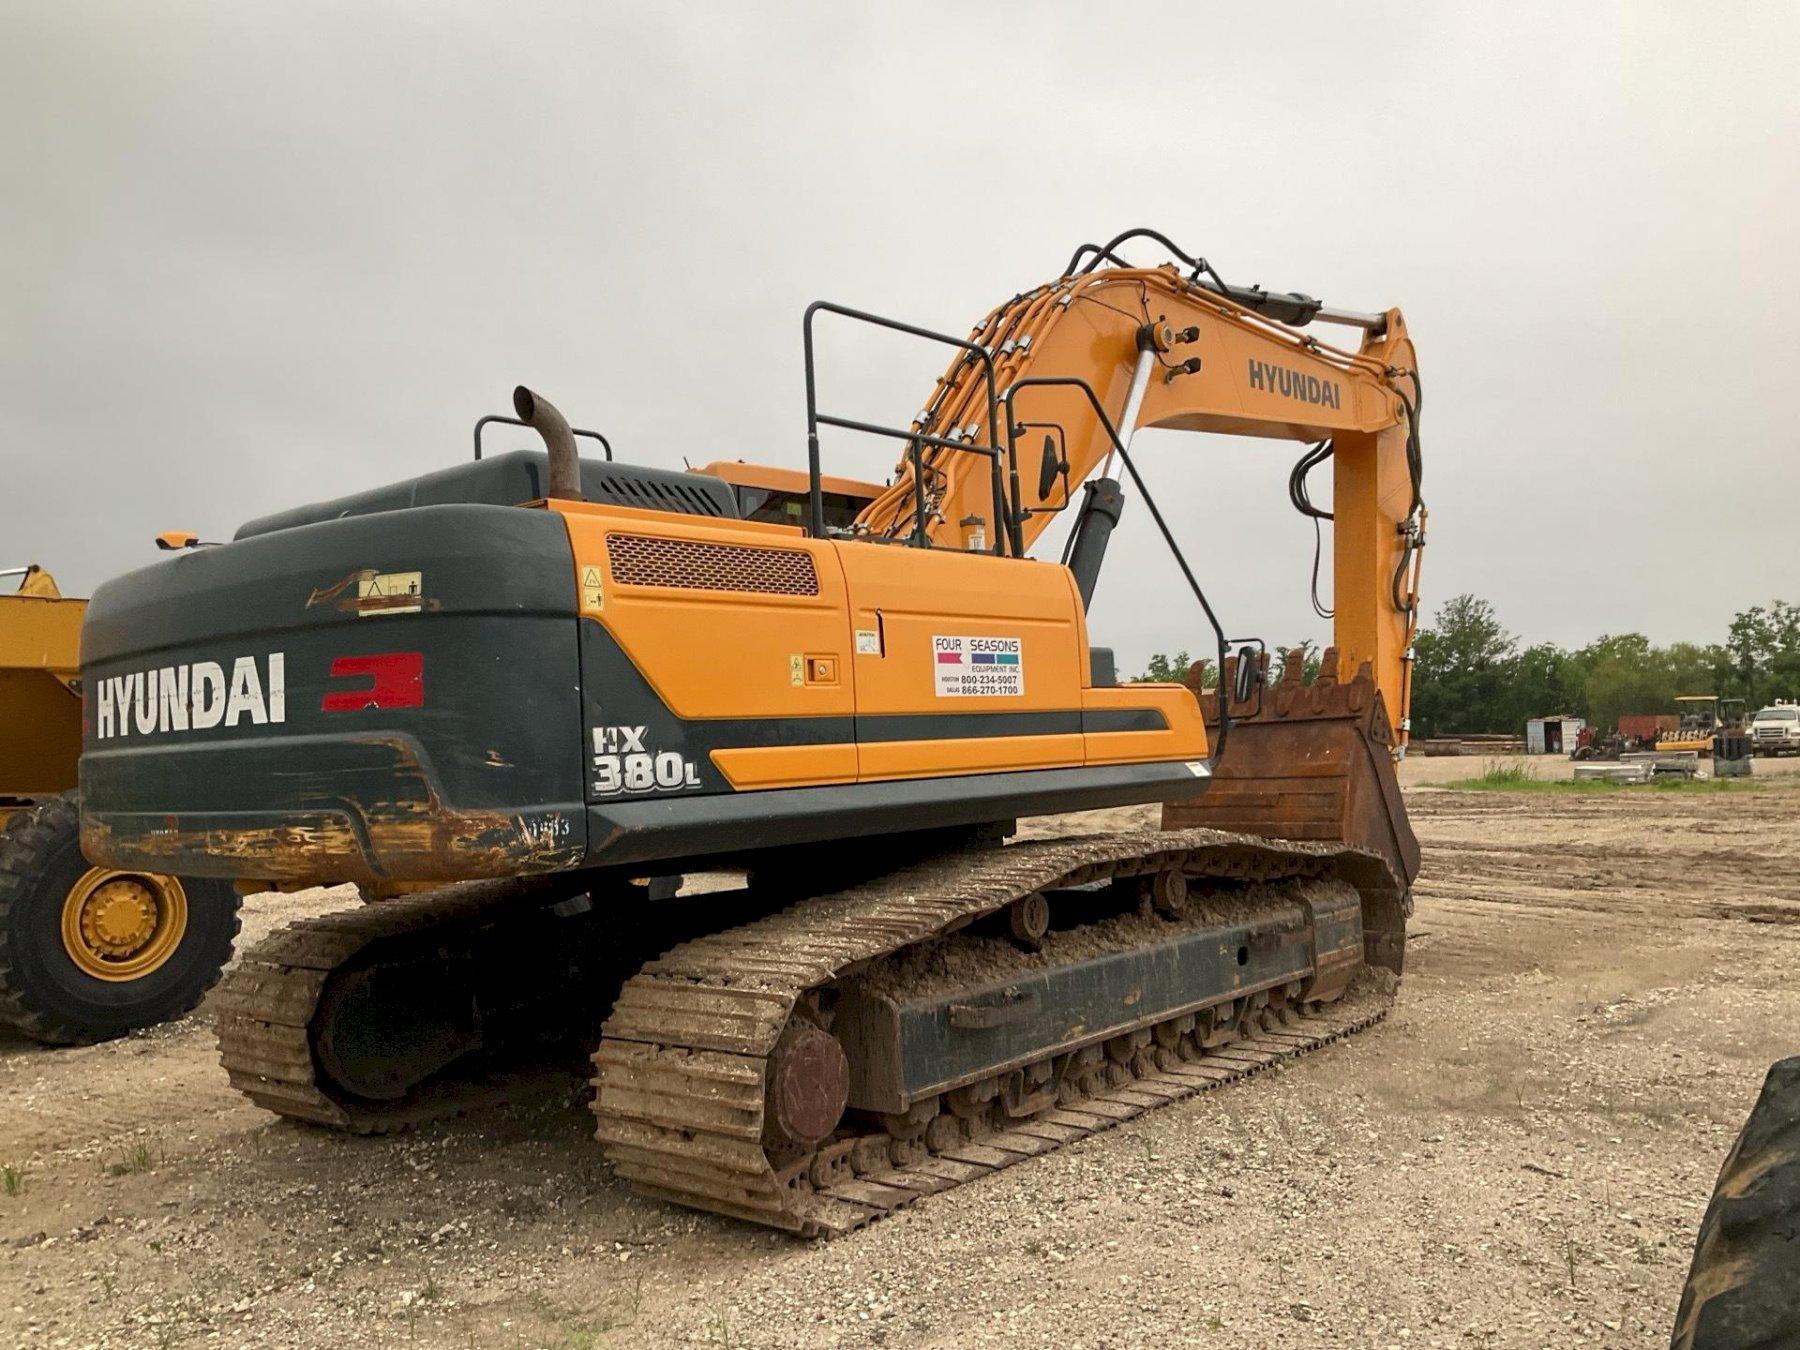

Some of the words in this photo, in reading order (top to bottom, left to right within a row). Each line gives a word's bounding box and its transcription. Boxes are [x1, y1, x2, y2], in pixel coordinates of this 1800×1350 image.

[1248, 358, 1340, 411] HYUNDAI
[936, 638, 962, 650] FOUR
[970, 639, 1019, 652] SEASONS
[961, 675, 1017, 684] 800-234-5007
[971, 665, 1007, 673] EQUIPMENT
[97, 652, 286, 739] HYUNDAI
[961, 685, 1018, 694] 866-270-1700
[592, 726, 648, 754] HX
[592, 751, 702, 793] 380L
